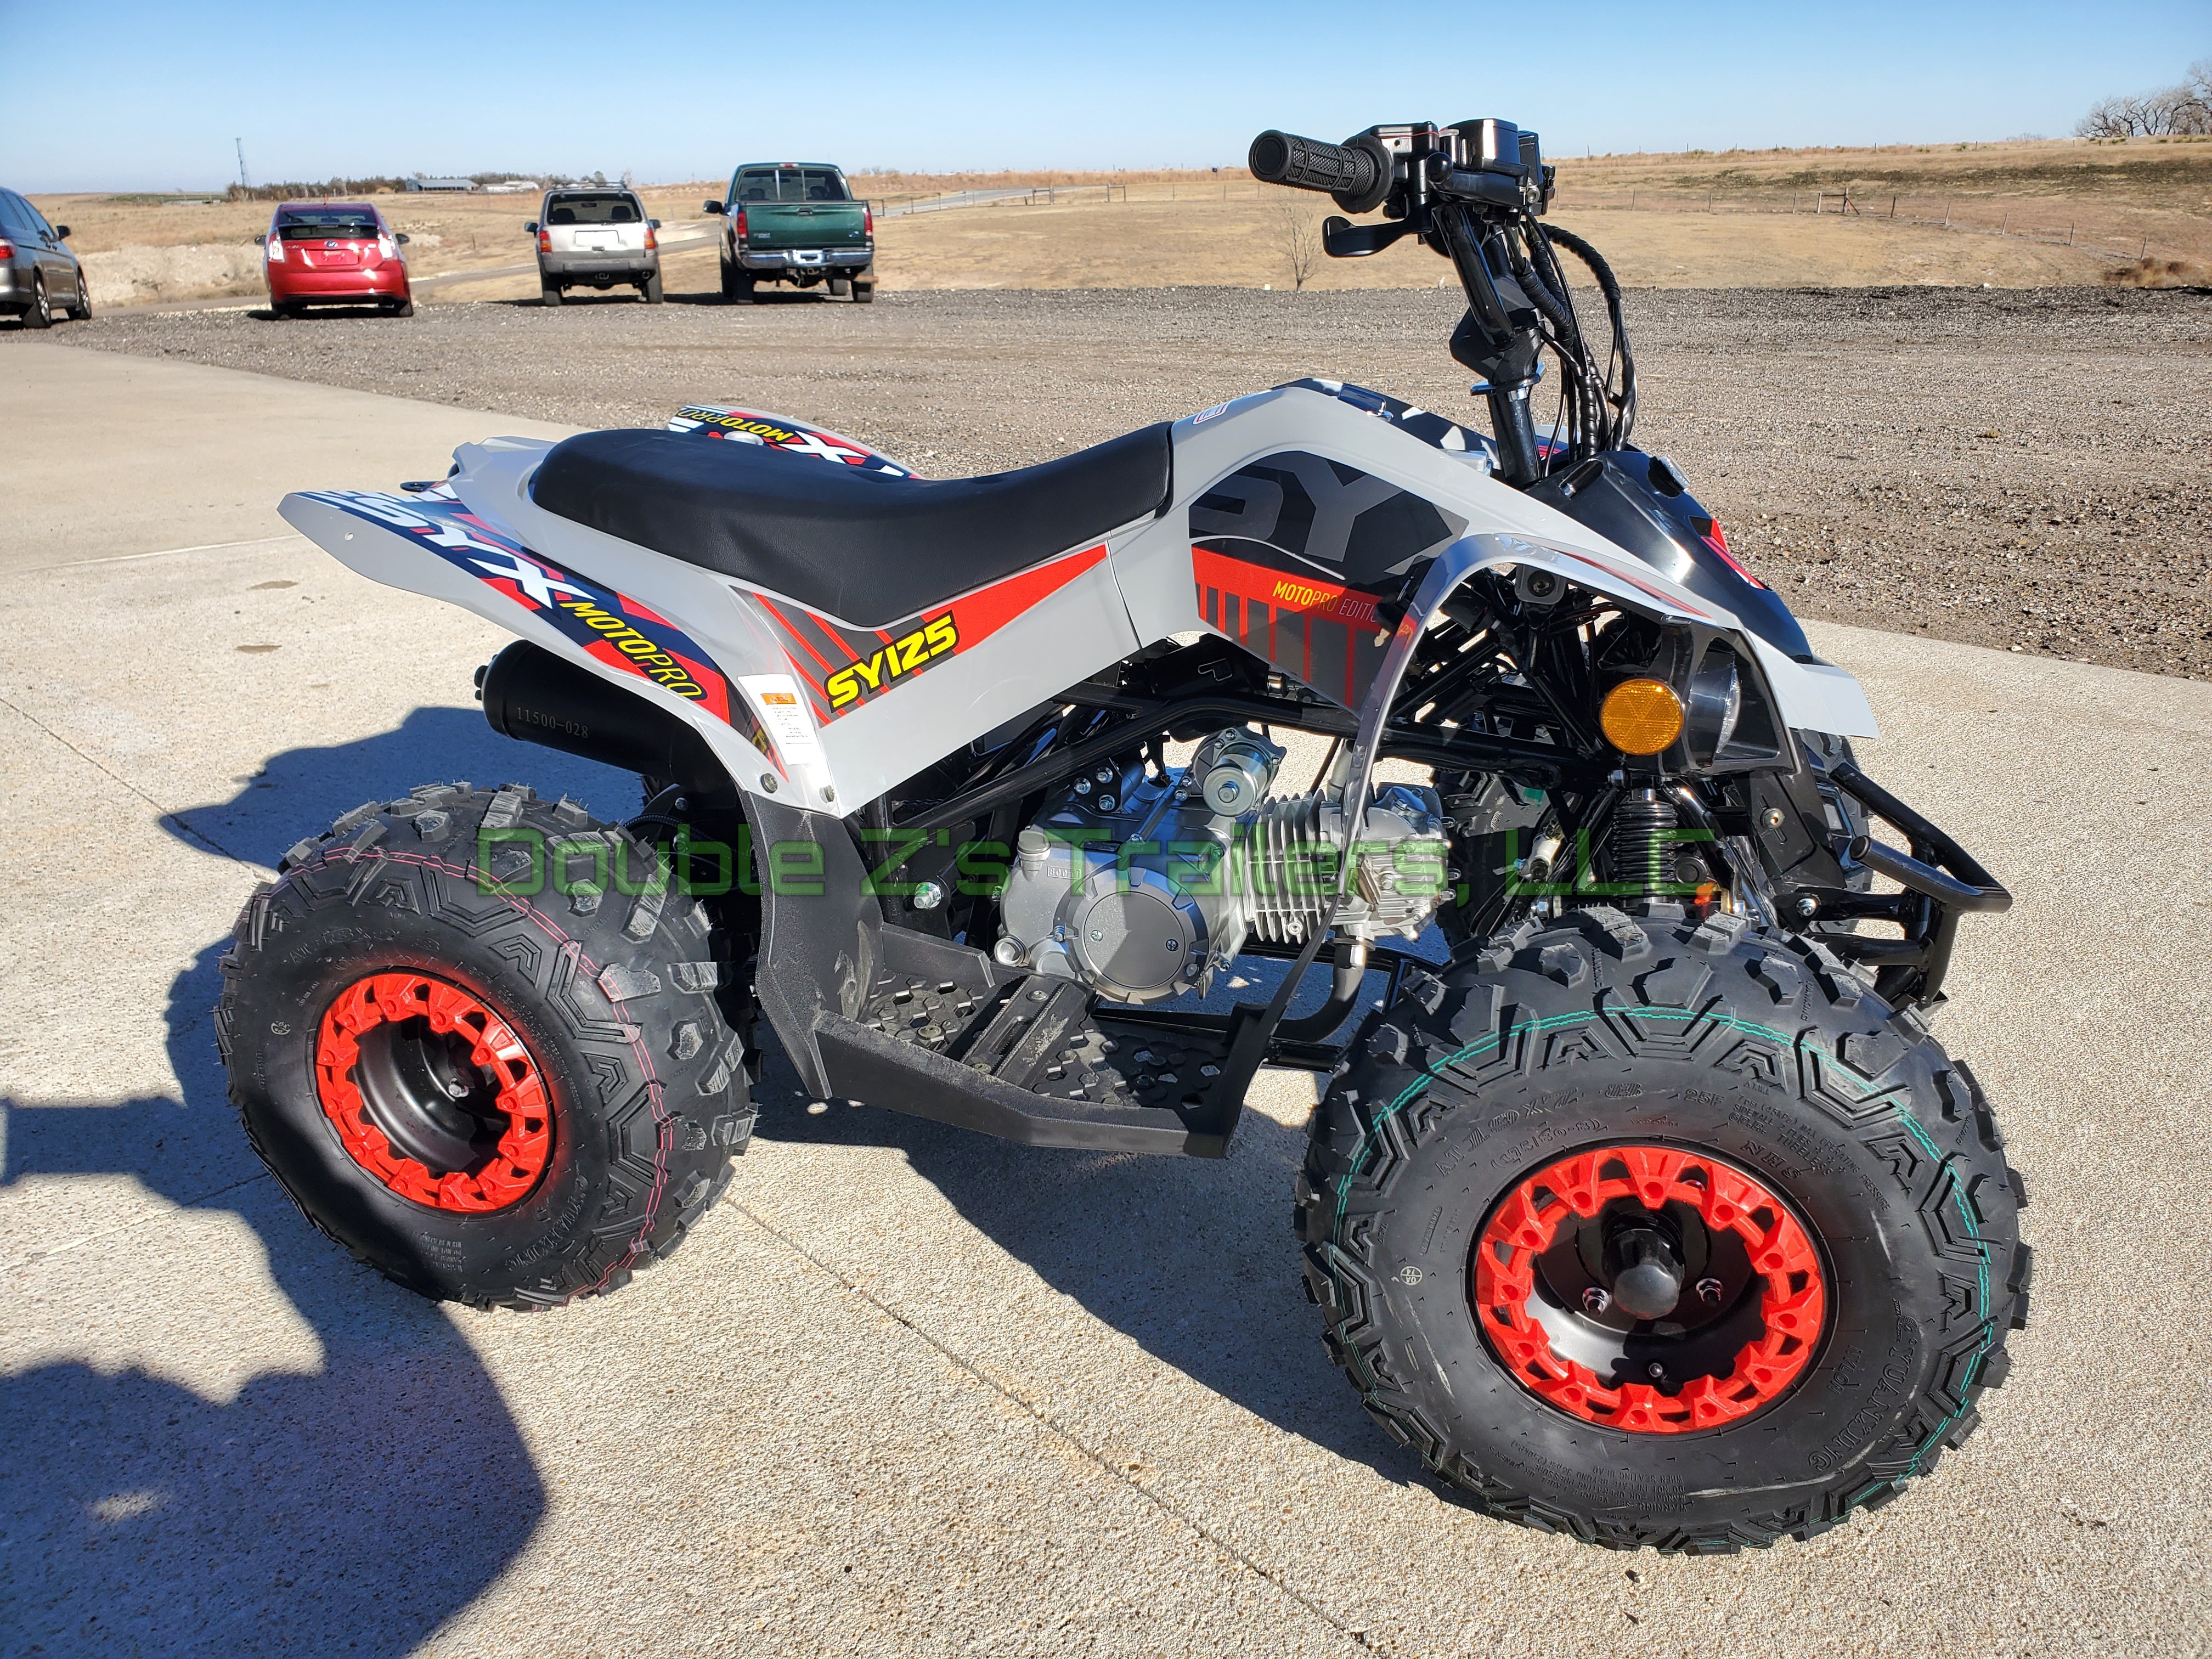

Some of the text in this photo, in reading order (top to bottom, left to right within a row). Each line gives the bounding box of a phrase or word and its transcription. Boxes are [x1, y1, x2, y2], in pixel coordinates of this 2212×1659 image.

[679, 409, 793, 442] MOTOPRO
[1272, 580, 1338, 613] MOTOPRO
[560, 602, 702, 697] MOTOPRO
[827, 614, 957, 708] SY125
[517, 707, 589, 738] 11500-028
[1684, 1088, 1724, 1107] 25F
[1732, 1103, 1774, 1126] SIDEWALL
[1787, 1127, 1813, 1147] PLIES
[1740, 1140, 1804, 1180] NHS
[1776, 1133, 1834, 1177] TUBELESS
[1819, 1137, 1860, 1173] OPERATING
[1859, 1173, 1892, 1211] PRESSURE
[1827, 1345, 1863, 1396] NYLON
[1808, 1346, 1915, 1471] YUANXING
[1532, 1463, 1575, 1486] PRESSURE
[1575, 1471, 1609, 1486] BEYOND
[1659, 1472, 1683, 1482] WHEN
